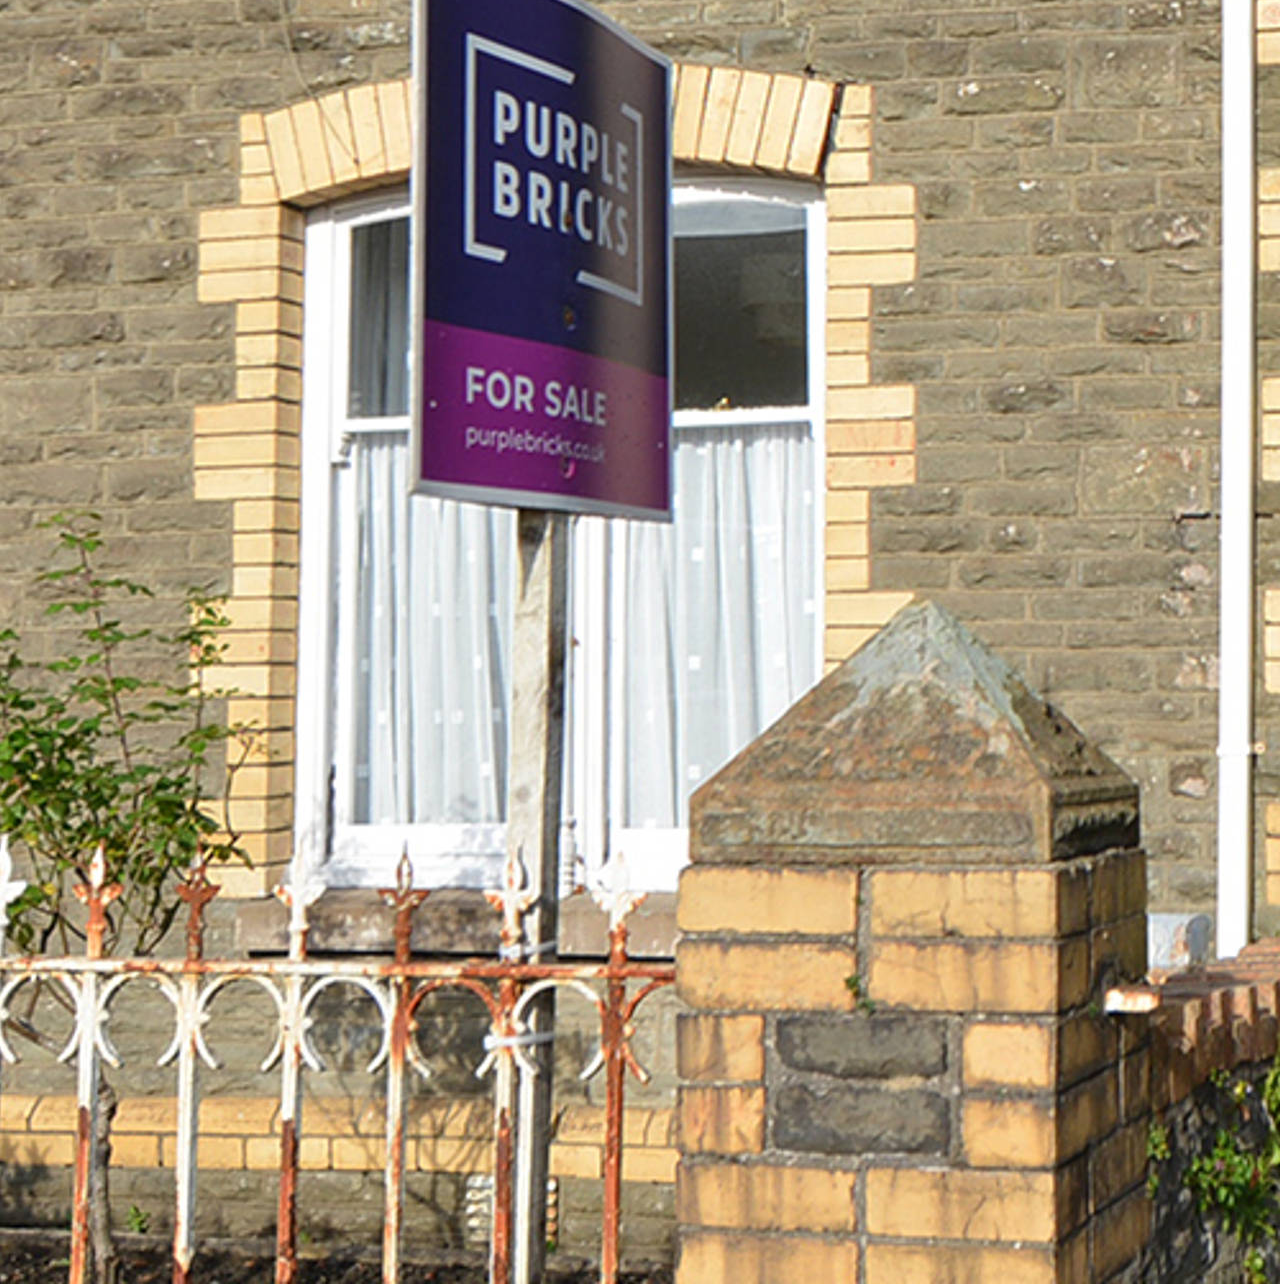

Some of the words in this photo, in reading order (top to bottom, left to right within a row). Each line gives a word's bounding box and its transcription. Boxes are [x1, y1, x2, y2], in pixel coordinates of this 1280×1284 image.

[494, 90, 628, 194] PURPLE
[493, 160, 629, 257] BRICKS
[466, 366, 534, 413] FOR
[544, 380, 607, 427] SALE
